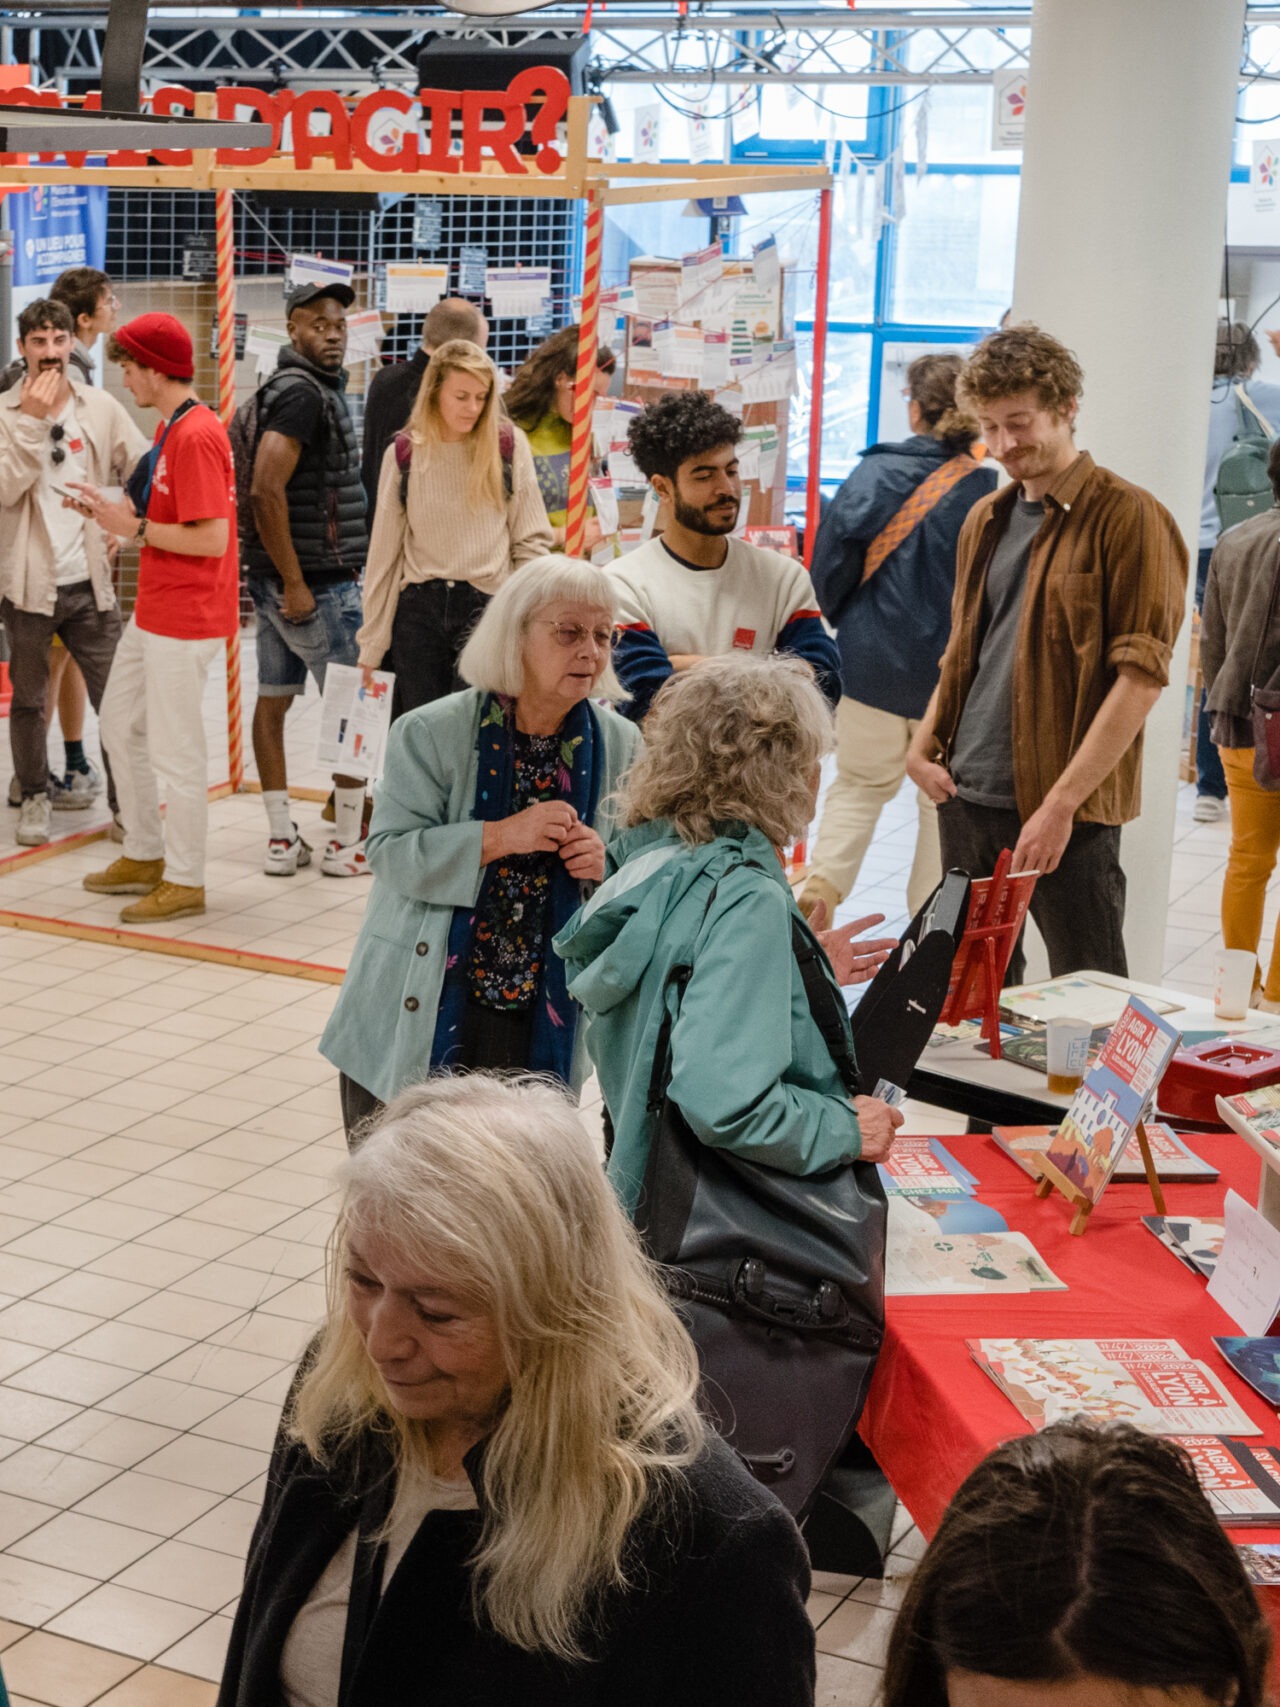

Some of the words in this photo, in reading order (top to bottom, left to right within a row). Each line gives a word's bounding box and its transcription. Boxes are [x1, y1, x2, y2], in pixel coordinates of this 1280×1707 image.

[1128, 1017, 1147, 1040] AGIR
[1144, 1026, 1155, 1045] À
[1116, 1032, 1146, 1068] LYON
[892, 1153, 928, 1175] LYON
[1151, 1371, 1199, 1406] LYON
[1179, 1371, 1210, 1395] AGIR
[1197, 1397, 1222, 1406] À
[1201, 1448, 1237, 1475] AGIR
[1225, 1478, 1251, 1487] À
